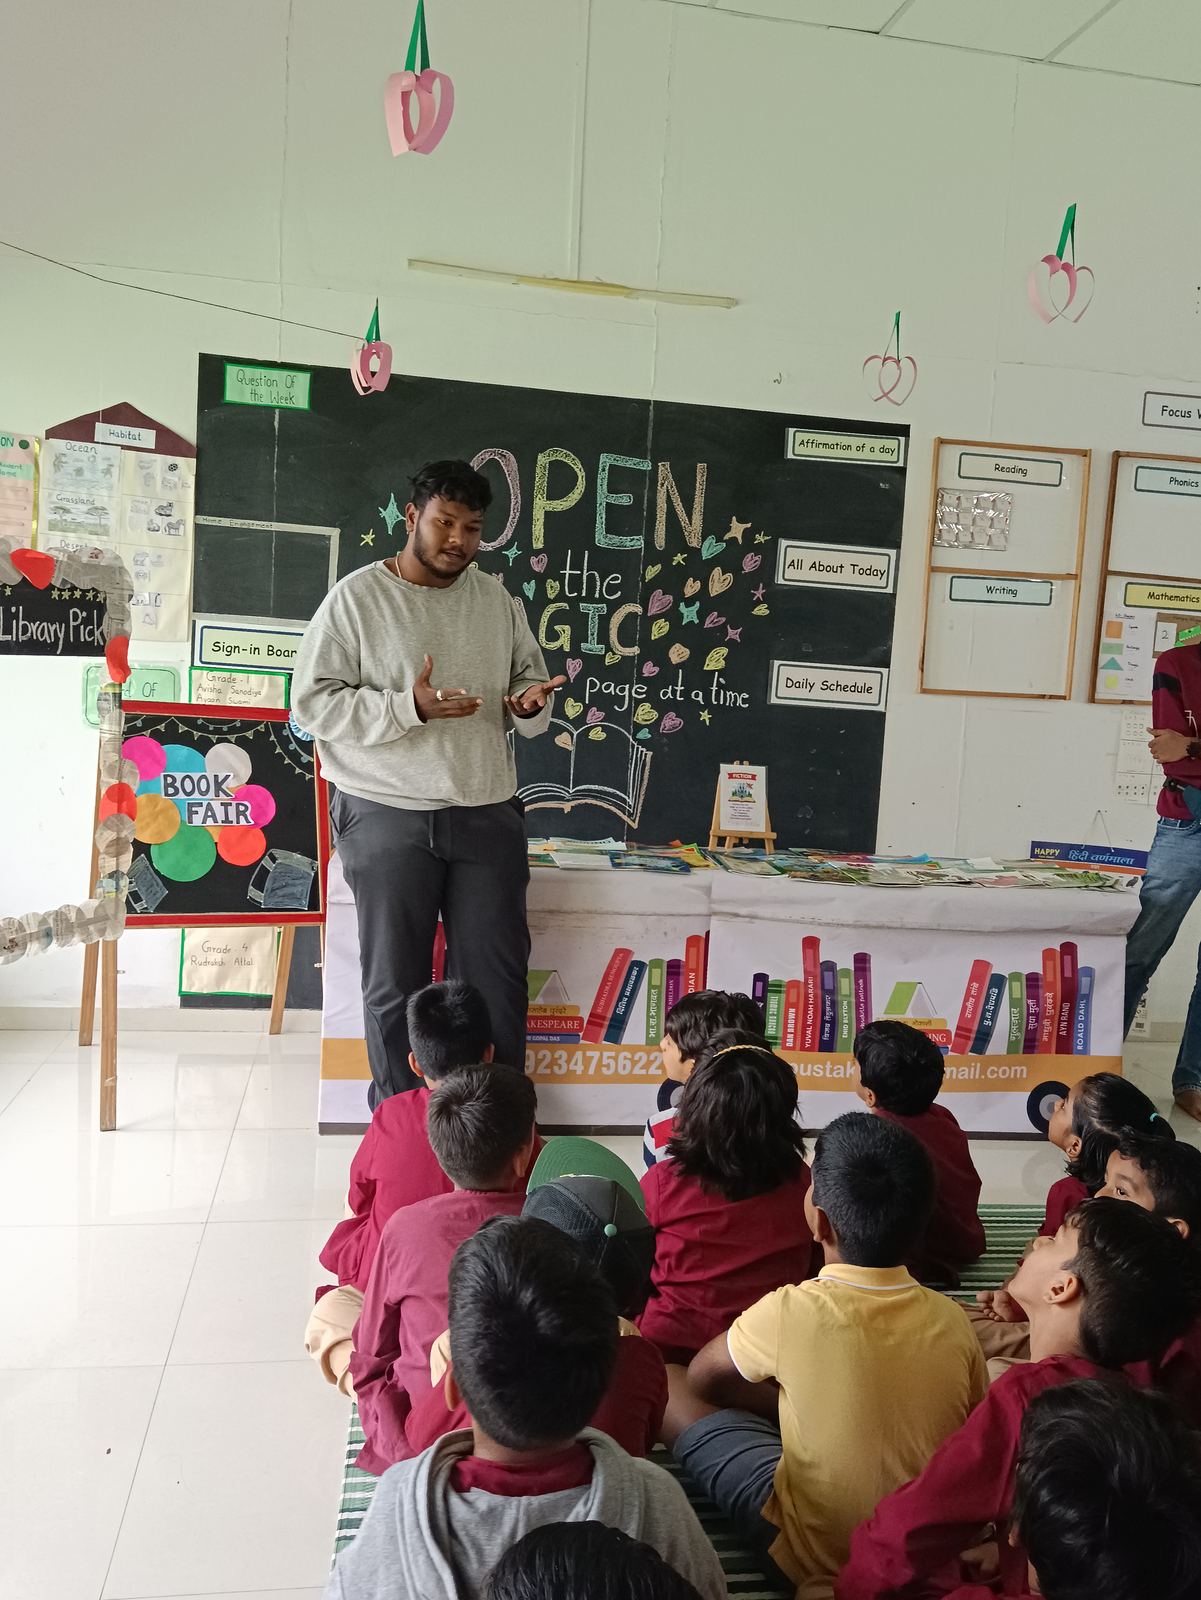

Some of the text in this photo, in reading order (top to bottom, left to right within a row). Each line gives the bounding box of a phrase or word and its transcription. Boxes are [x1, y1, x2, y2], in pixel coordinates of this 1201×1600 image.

[236, 369, 297, 389] Question Of
[250, 389, 296, 405] the Week
[1161, 405, 1192, 419] Focus
[108, 429, 142, 441] Habitat
[65, 441, 98, 454] Ocean
[798, 439, 852, 452] Affirmation
[856, 443, 866, 453] of
[878, 445, 896, 456] day
[994, 463, 1028, 477] Reading
[1169, 476, 1199, 488] Phonics
[56, 493, 96, 506] Grassland
[470, 448, 707, 550] OPEN
[560, 550, 622, 599] the
[787, 559, 886, 580] All About Today
[986, 585, 1018, 597] Writing
[1147, 591, 1200, 603] Mathematics
[0, 606, 65, 655] Library
[539, 602, 643, 657] GIC
[211, 641, 297, 658] Sign-in Boar
[206, 671, 237, 684] Grade
[785, 677, 873, 694] Daily Schedule
[586, 669, 749, 711] page at a time
[163, 774, 232, 798] BOOK
[187, 802, 252, 825] FAIR
[1034, 848, 1060, 856] HAPPY
[202, 941, 231, 953] Grade
[688, 972, 696, 994] DIAN
[786, 1008, 796, 1047] DAN BROWN
[1059, 1002, 1070, 1036] AYN RAND
